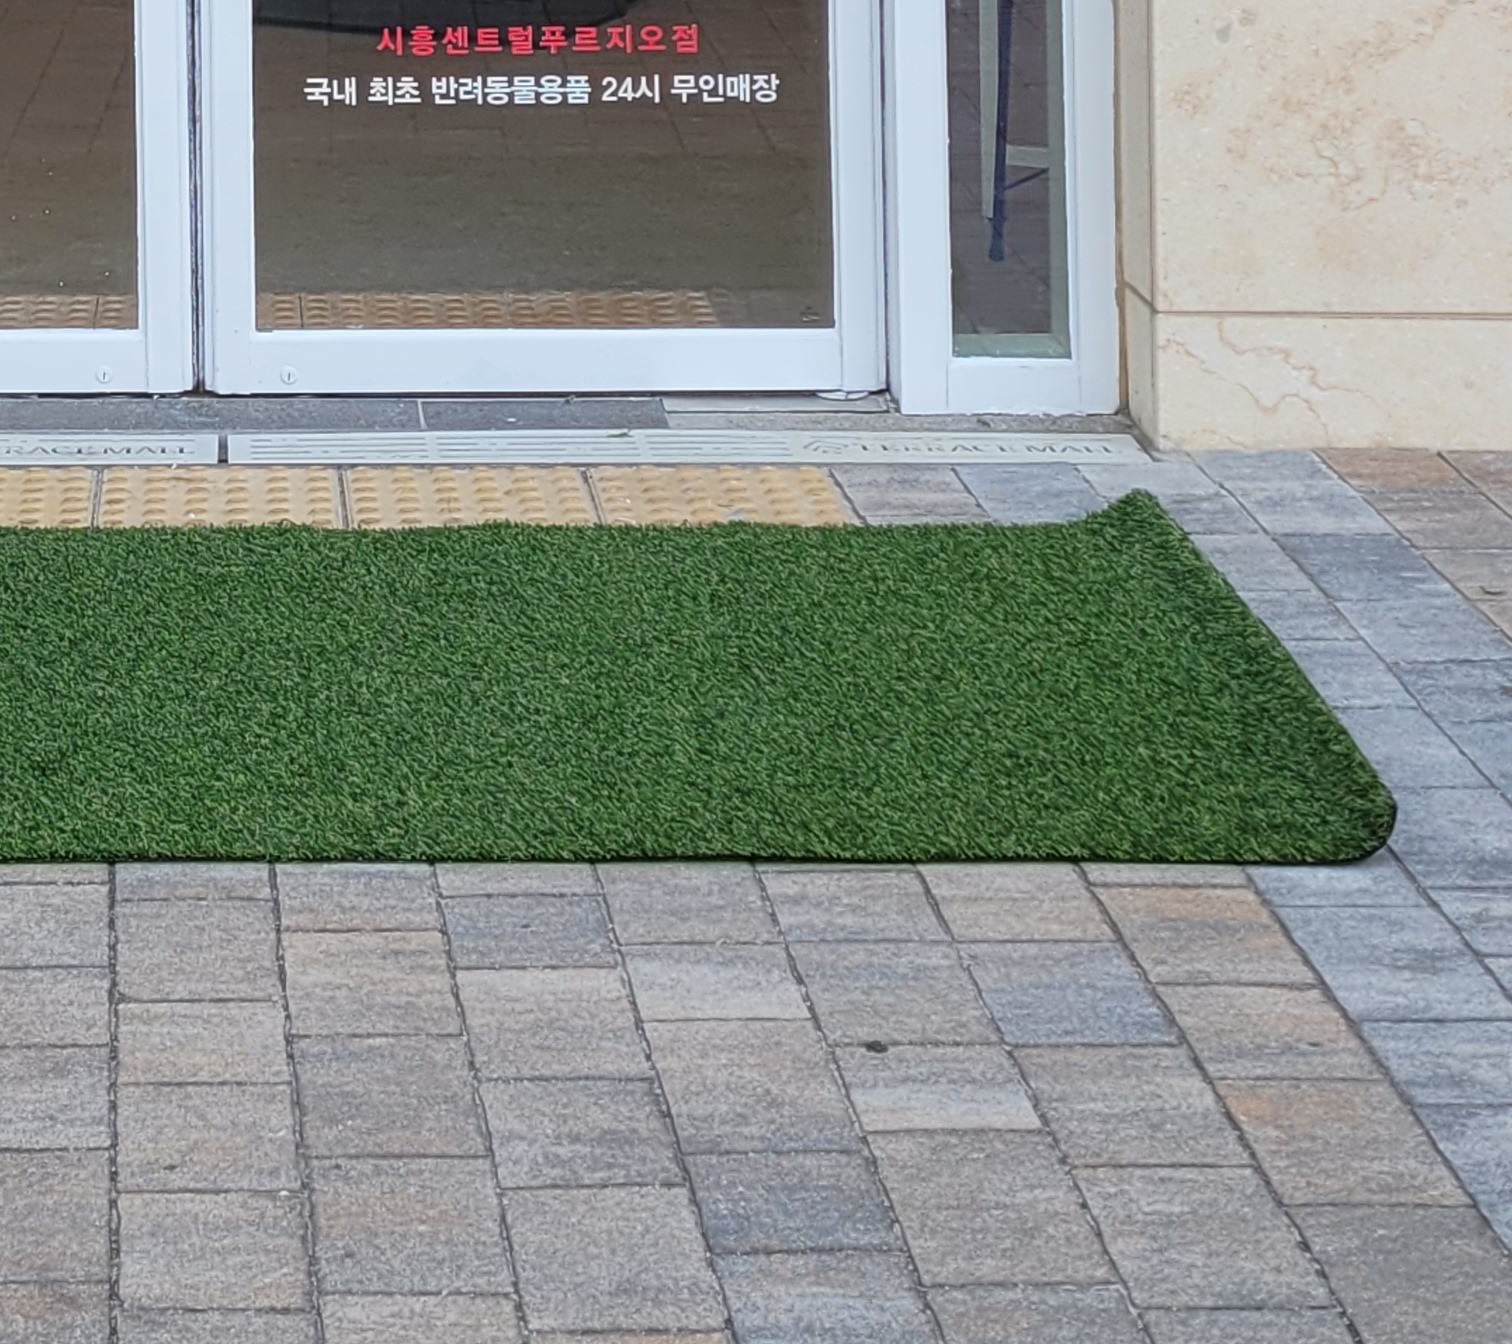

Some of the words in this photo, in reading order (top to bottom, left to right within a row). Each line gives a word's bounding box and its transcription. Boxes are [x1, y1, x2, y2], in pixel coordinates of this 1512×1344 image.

[376, 24, 699, 57] 시흥센트럴푸르지오점
[304, 77, 356, 106] 국내
[368, 77, 421, 105] 최초
[432, 75, 591, 104] 반려동물용품
[602, 74, 659, 103] 24시
[671, 74, 779, 102] 무인매장
